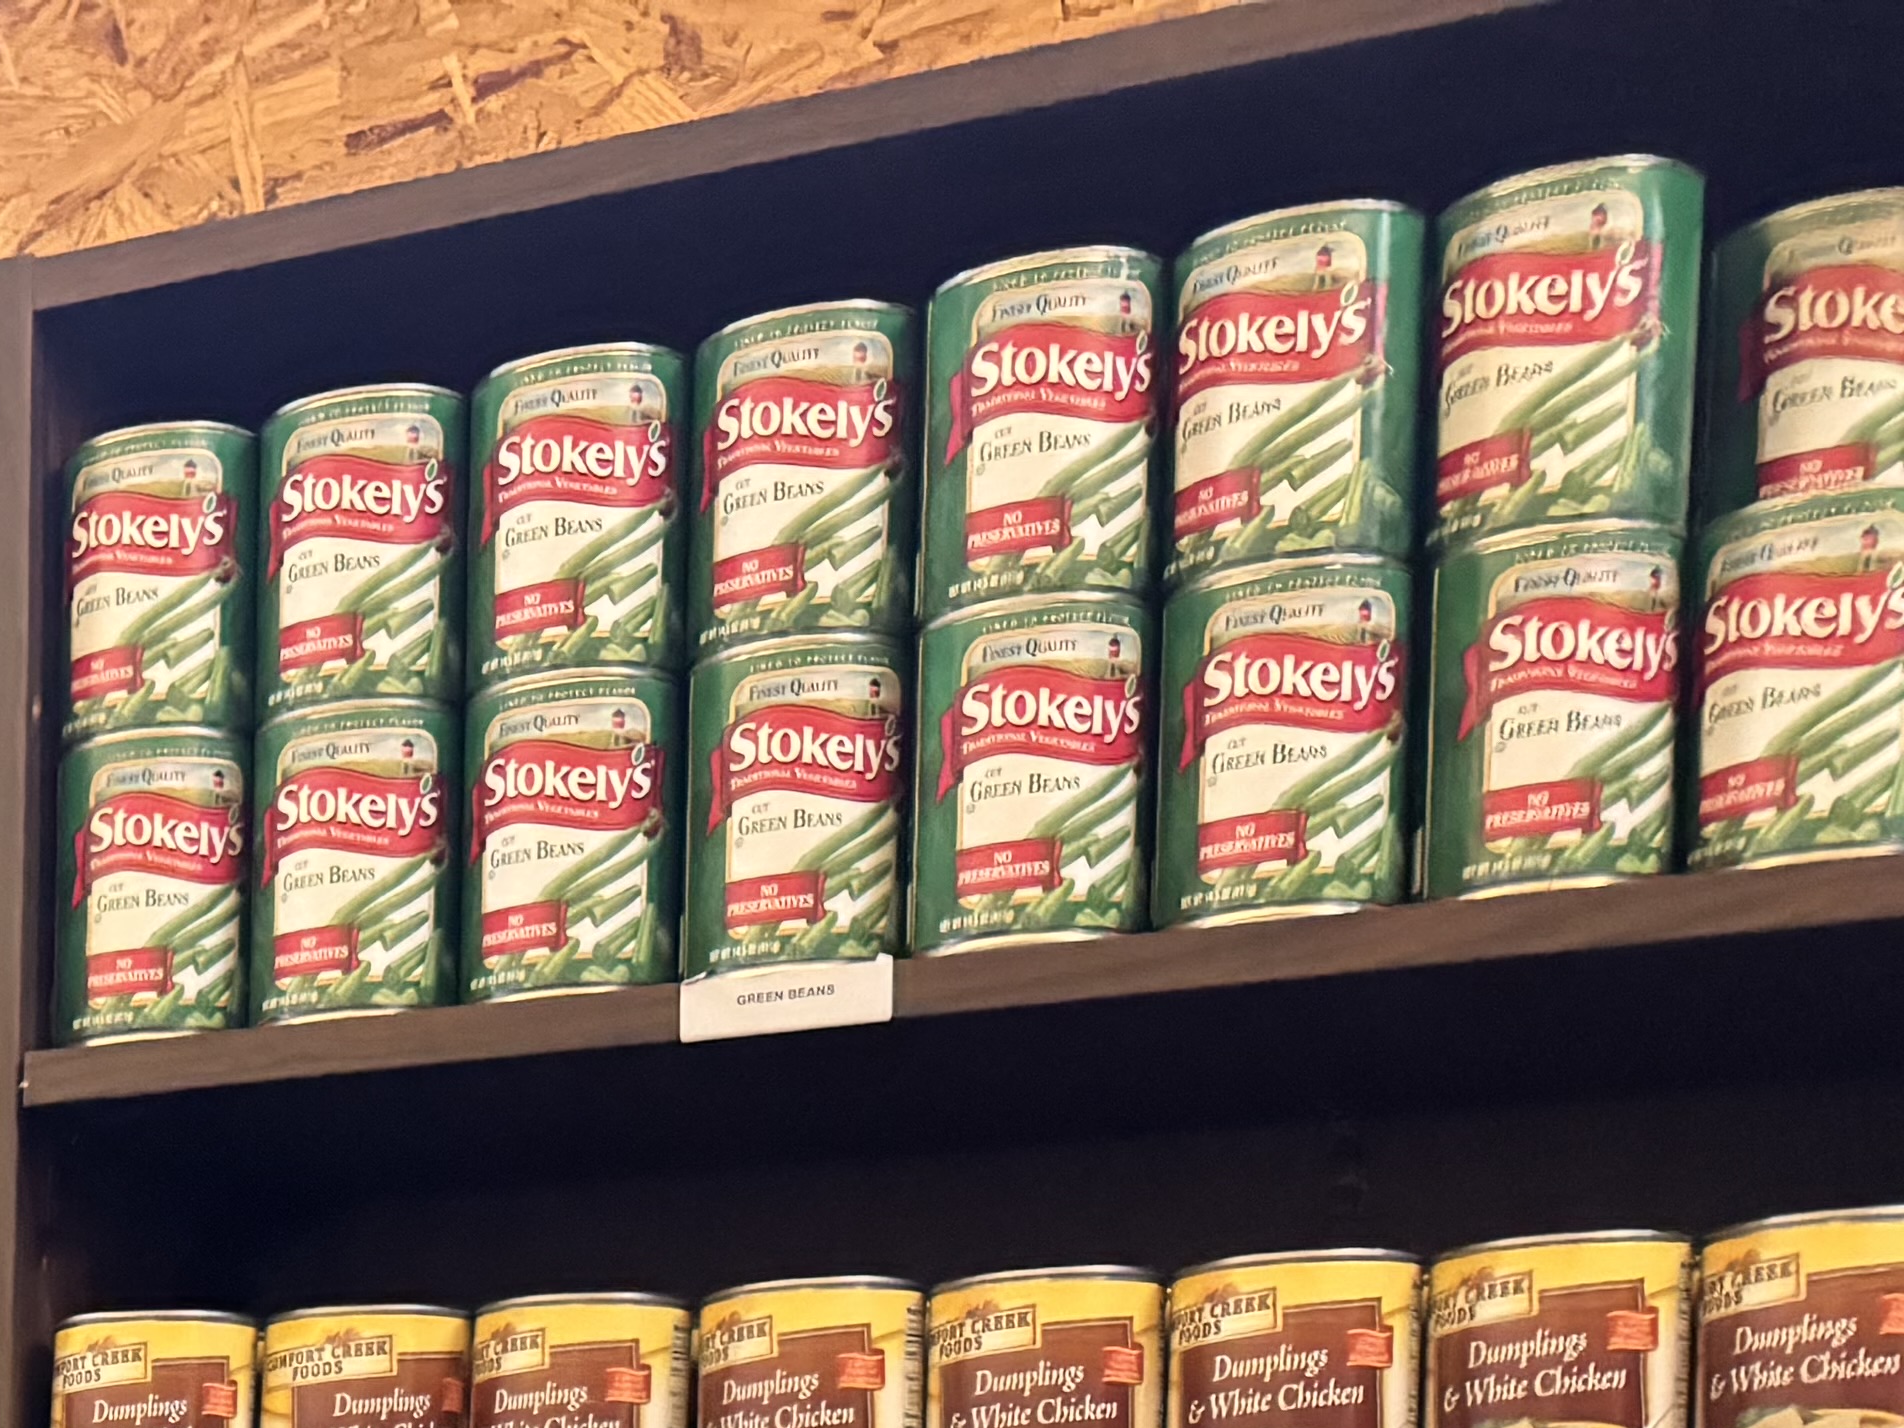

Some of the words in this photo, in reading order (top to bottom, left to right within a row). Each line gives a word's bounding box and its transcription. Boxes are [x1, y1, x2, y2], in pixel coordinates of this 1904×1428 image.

[1442, 240, 1645, 338] Stokely's
[1179, 283, 1369, 374] Stokely's
[1764, 285, 1904, 343] Stoke
[970, 330, 1151, 400] Stokely's
[716, 380, 892, 450] Stokely's
[497, 421, 667, 485] Stokely's
[979, 440, 1032, 463] GREEN
[1038, 430, 1091, 451] BEANS
[282, 458, 444, 522] Stokely's
[72, 492, 224, 557] Stokely's
[505, 527, 549, 547] GREEN
[554, 517, 603, 535] BEANS
[1705, 562, 1904, 655] Stokely's
[1489, 602, 1678, 680] Stokely's
[1203, 640, 1396, 709] Stokely's
[961, 675, 1140, 743] Stokely's
[729, 714, 900, 780] Stokely's
[484, 742, 652, 808] Stokely's
[276, 775, 439, 835] Stokely's
[738, 817, 787, 836] GREEN
[793, 810, 842, 828] BEANS
[90, 805, 242, 863] Stokely's
[97, 895, 140, 912] GREEN
[145, 890, 189, 908] BEANS
[727, 894, 814, 917] PRESERVATIVES
[760, 884, 778, 896] NO
[737, 990, 784, 1006] GREEN
[788, 984, 835, 1000] BEANS
[1468, 1330, 1587, 1368] Dumplings
[1734, 1315, 1858, 1355] Dumplings
[974, 1361, 1085, 1395] Dumplings
[1212, 1346, 1329, 1381] Dumplings
[334, 1389, 431, 1418] Dumplings
[494, 1382, 588, 1414] Dumplings
[722, 1371, 819, 1405] Dumplings
[1189, 1399, 1205, 1423] &
[1210, 1389, 1271, 1417] White
[1277, 1382, 1365, 1411] Chicken
[92, 1394, 187, 1424] Dumplings
[971, 1402, 1031, 1428] White
[1036, 1397, 1118, 1424] Chicken
